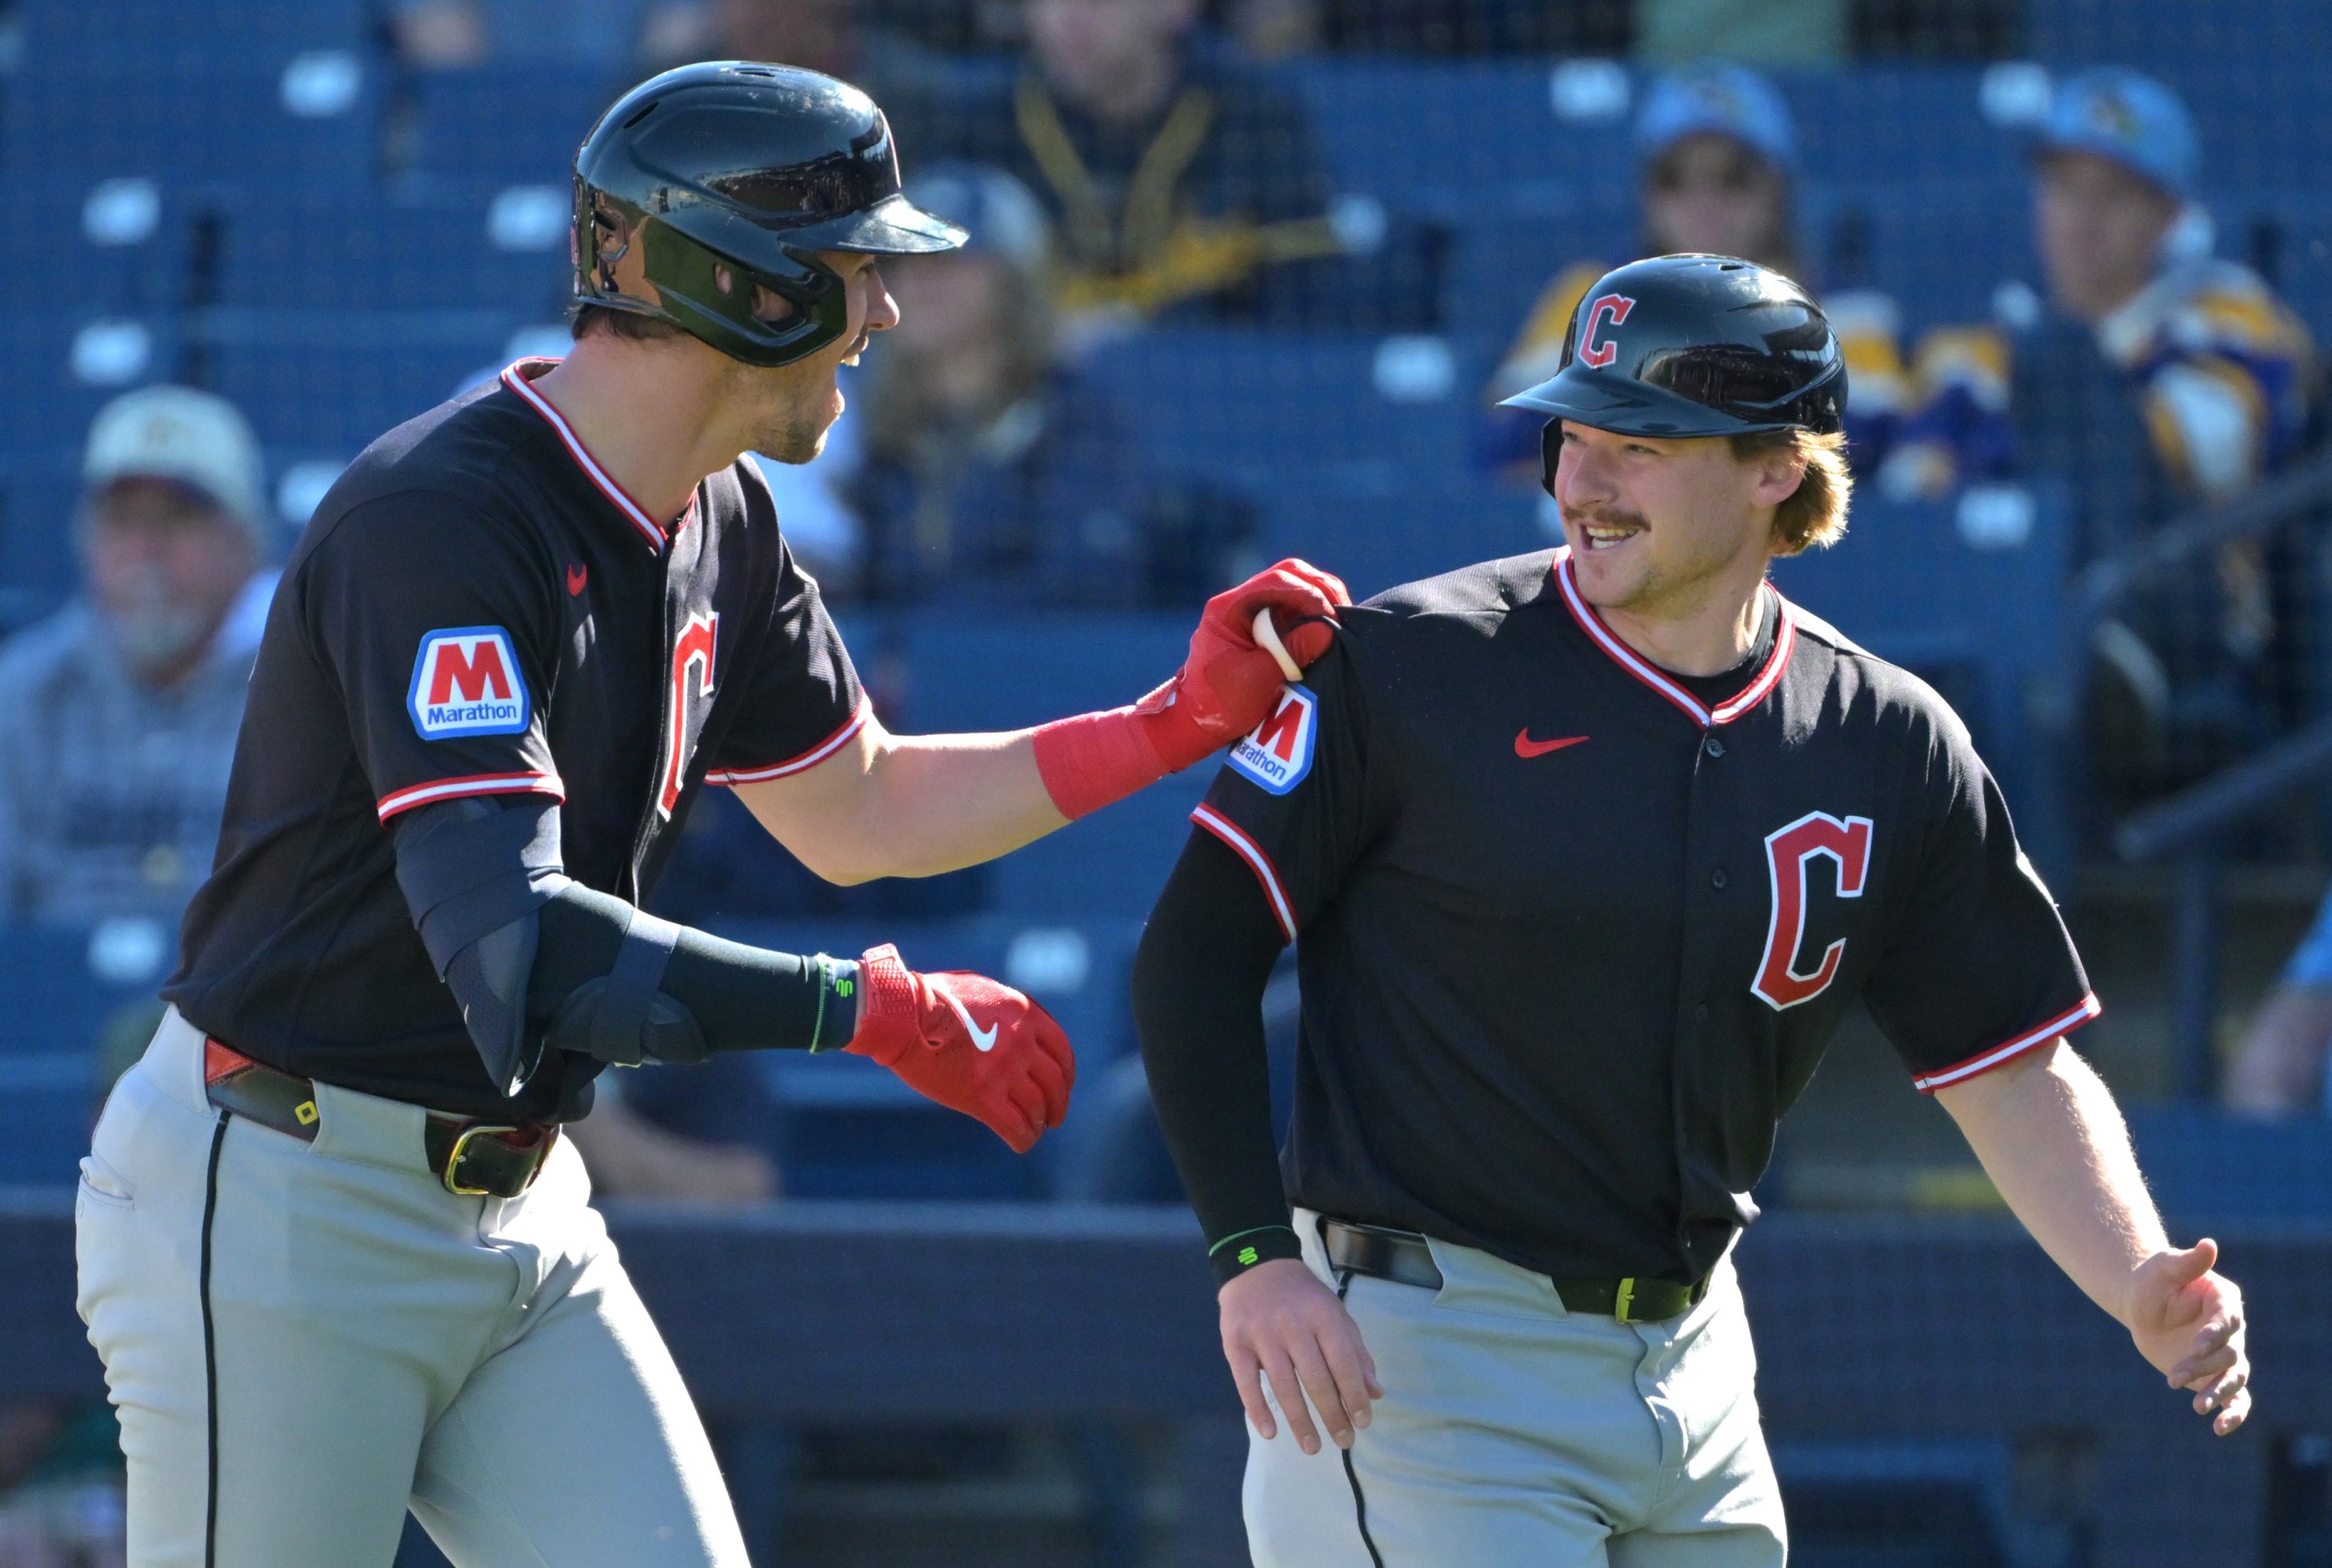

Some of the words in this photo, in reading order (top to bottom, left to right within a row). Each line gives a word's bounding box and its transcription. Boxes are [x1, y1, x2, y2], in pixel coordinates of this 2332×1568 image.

[1579, 293, 1636, 369] C
[429, 640, 512, 705] M
[427, 703, 517, 725] Marathon
[1236, 740, 1286, 780] arathon
[1750, 810, 1873, 1011] C
